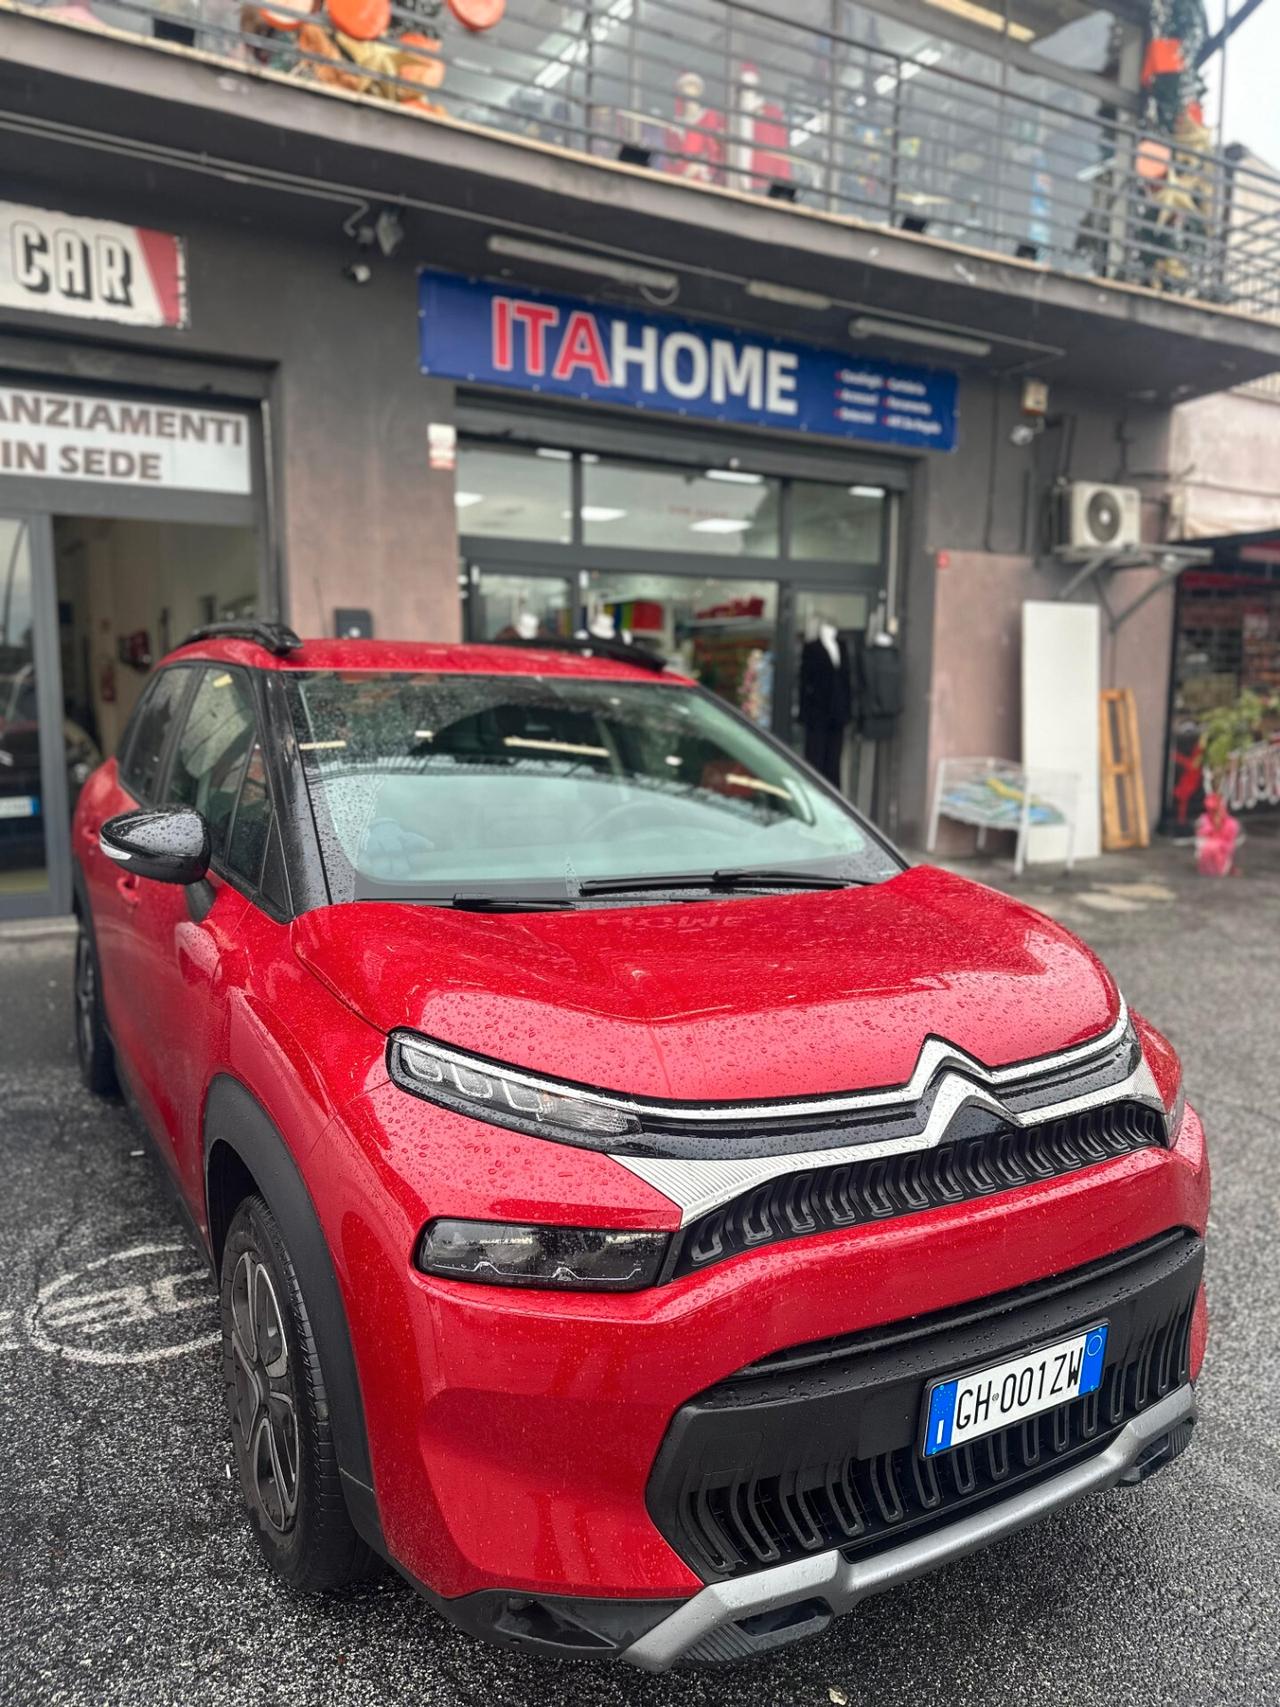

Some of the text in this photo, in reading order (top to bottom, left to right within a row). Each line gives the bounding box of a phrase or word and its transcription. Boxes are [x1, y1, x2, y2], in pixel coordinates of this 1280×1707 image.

[10, 219, 133, 308] CAR
[492, 295, 799, 415] ITAHOME
[1, 440, 162, 481] IN SEDE
